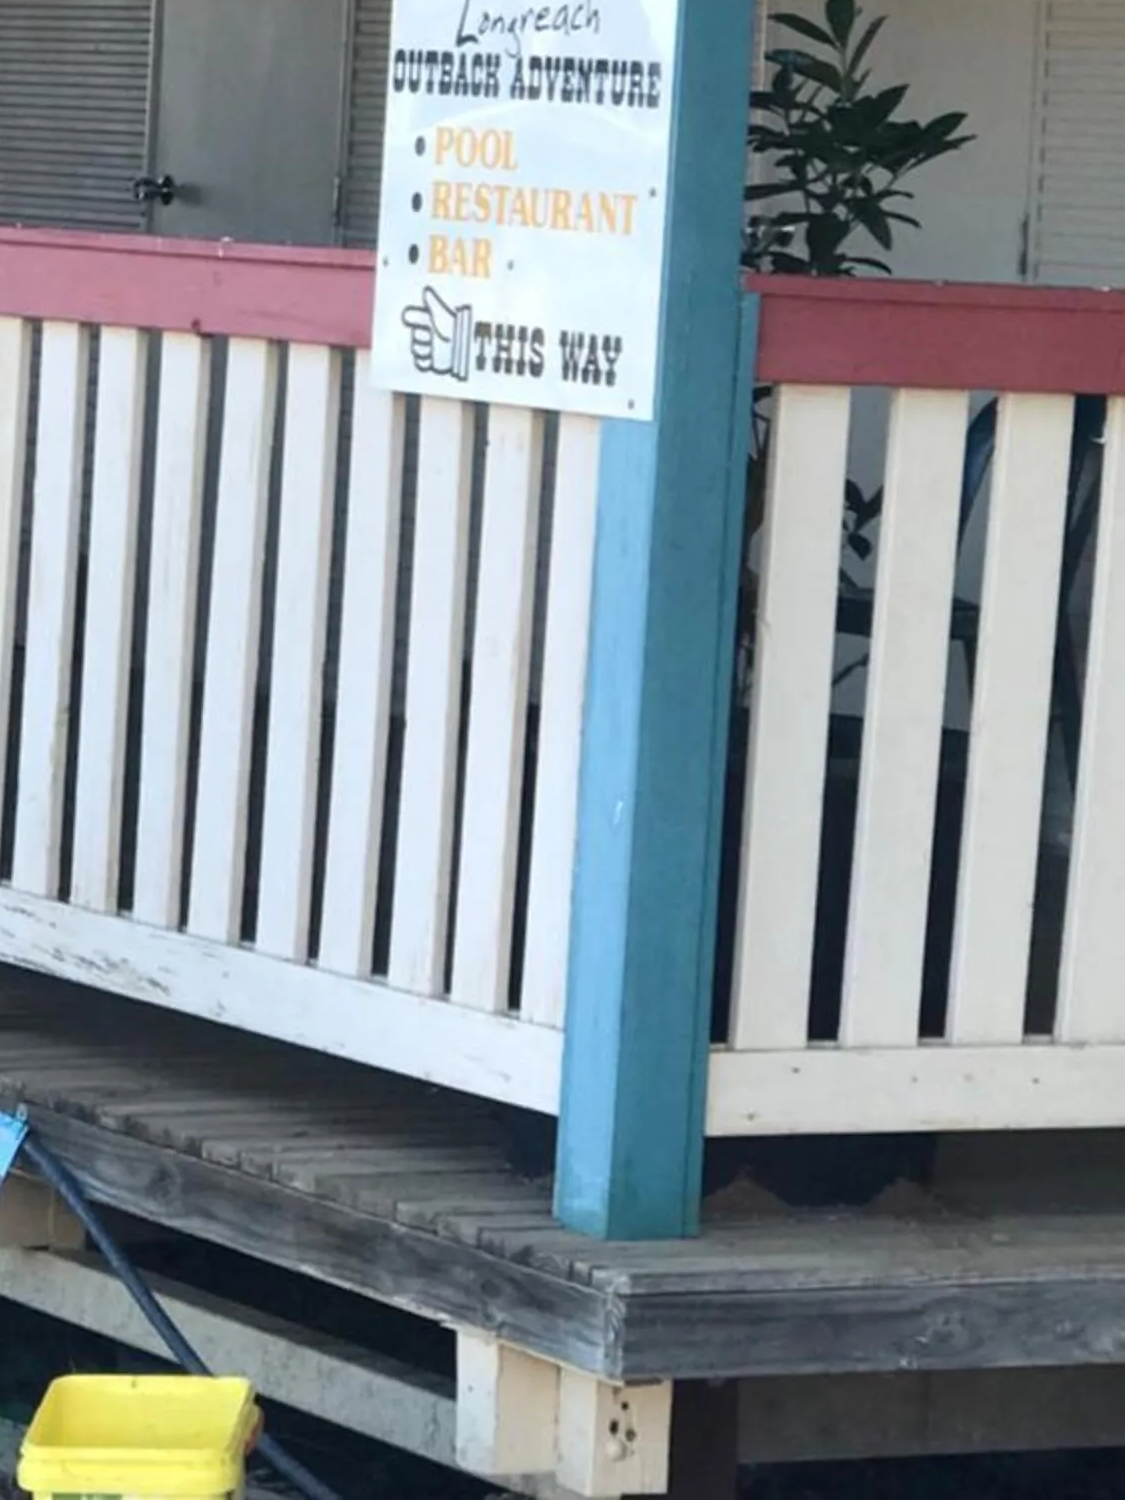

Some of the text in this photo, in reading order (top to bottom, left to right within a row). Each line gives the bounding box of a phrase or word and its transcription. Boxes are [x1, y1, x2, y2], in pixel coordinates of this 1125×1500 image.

[392, 48, 662, 108] OUTBACK ADVENTURE
[433, 126, 518, 170] POOL
[431, 181, 638, 235] RESTAURANT
[427, 234, 493, 279] BAR
[473, 321, 623, 387] THIS WAY
